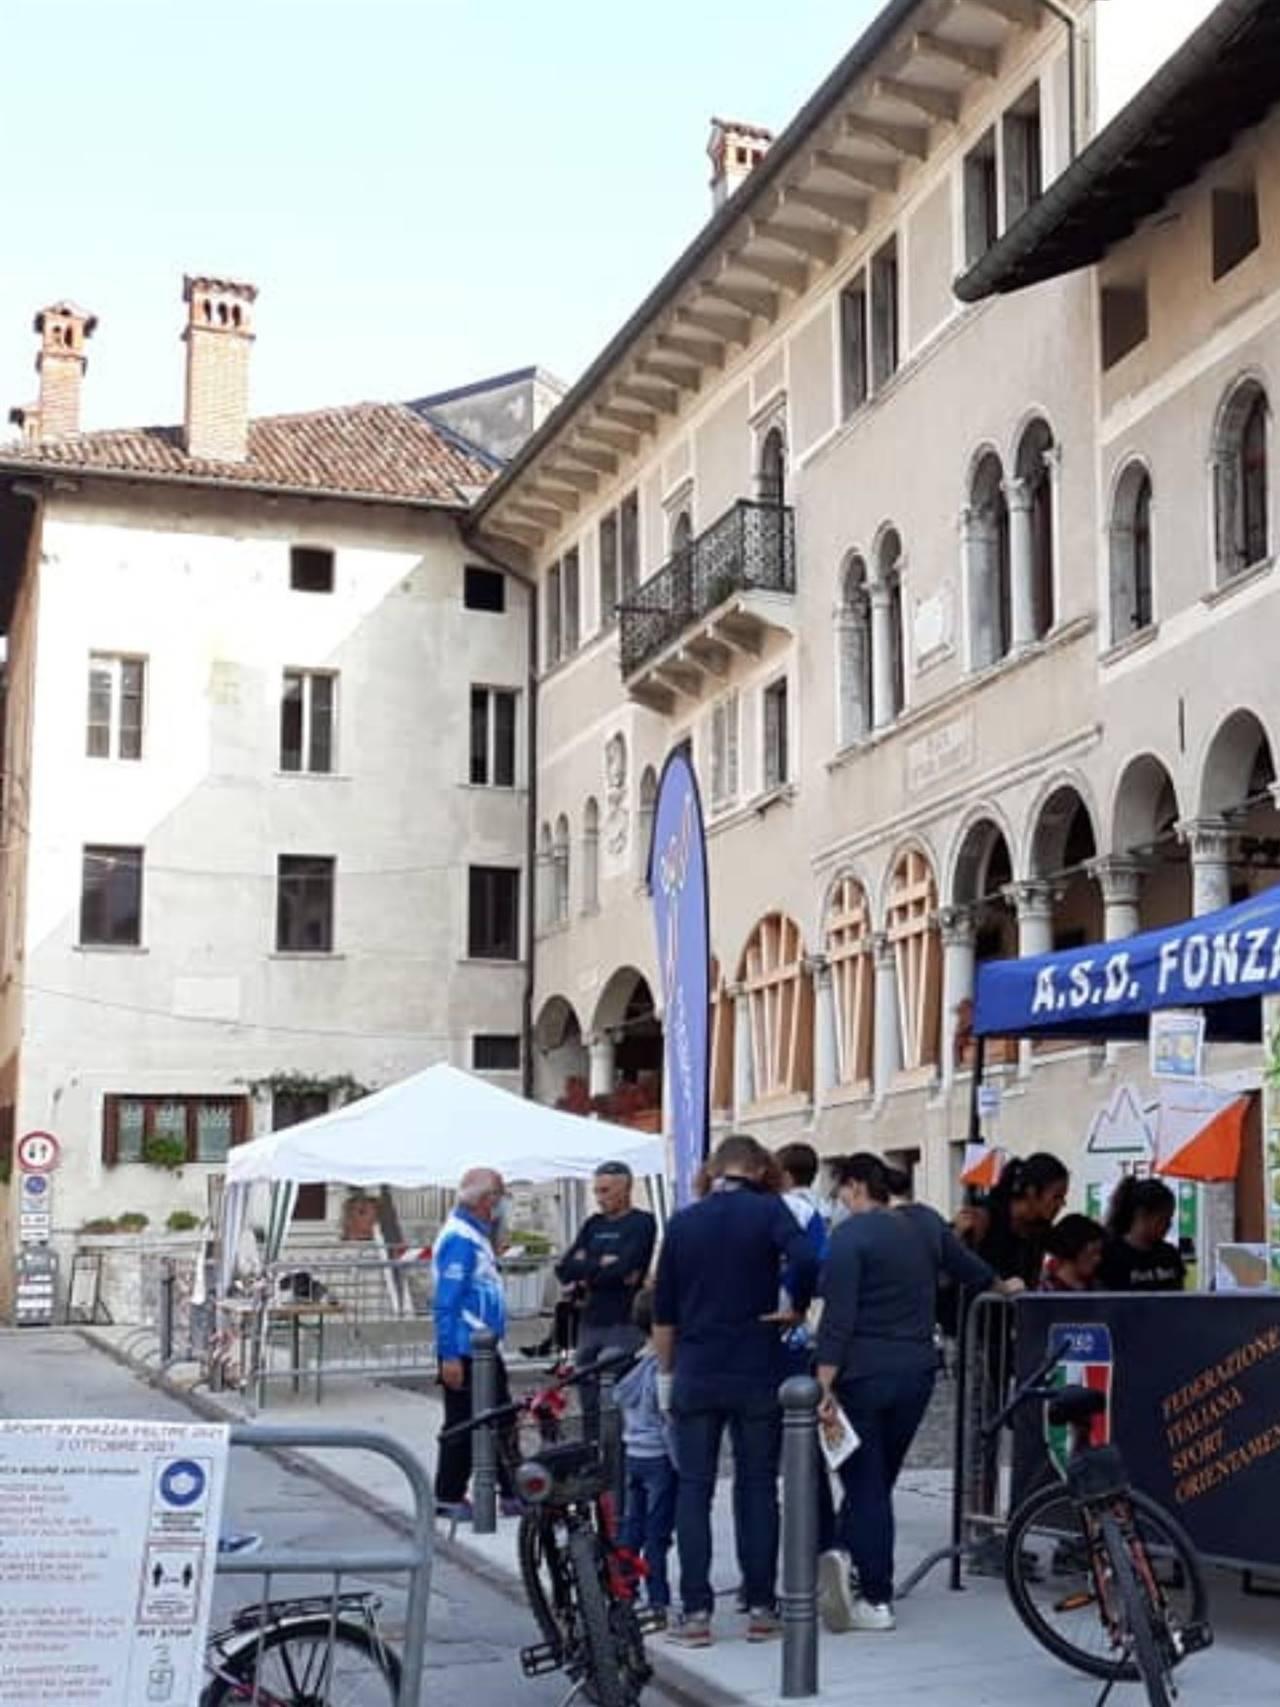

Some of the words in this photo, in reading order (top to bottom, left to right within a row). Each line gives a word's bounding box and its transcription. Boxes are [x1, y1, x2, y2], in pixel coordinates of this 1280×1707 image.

[1032, 951, 1139, 1013] A.S.D.
[1162, 1325, 1280, 1420] FEDERAZIONE
[1167, 1386, 1243, 1449] ITALIANA
[1172, 1427, 1224, 1477] SPORT
